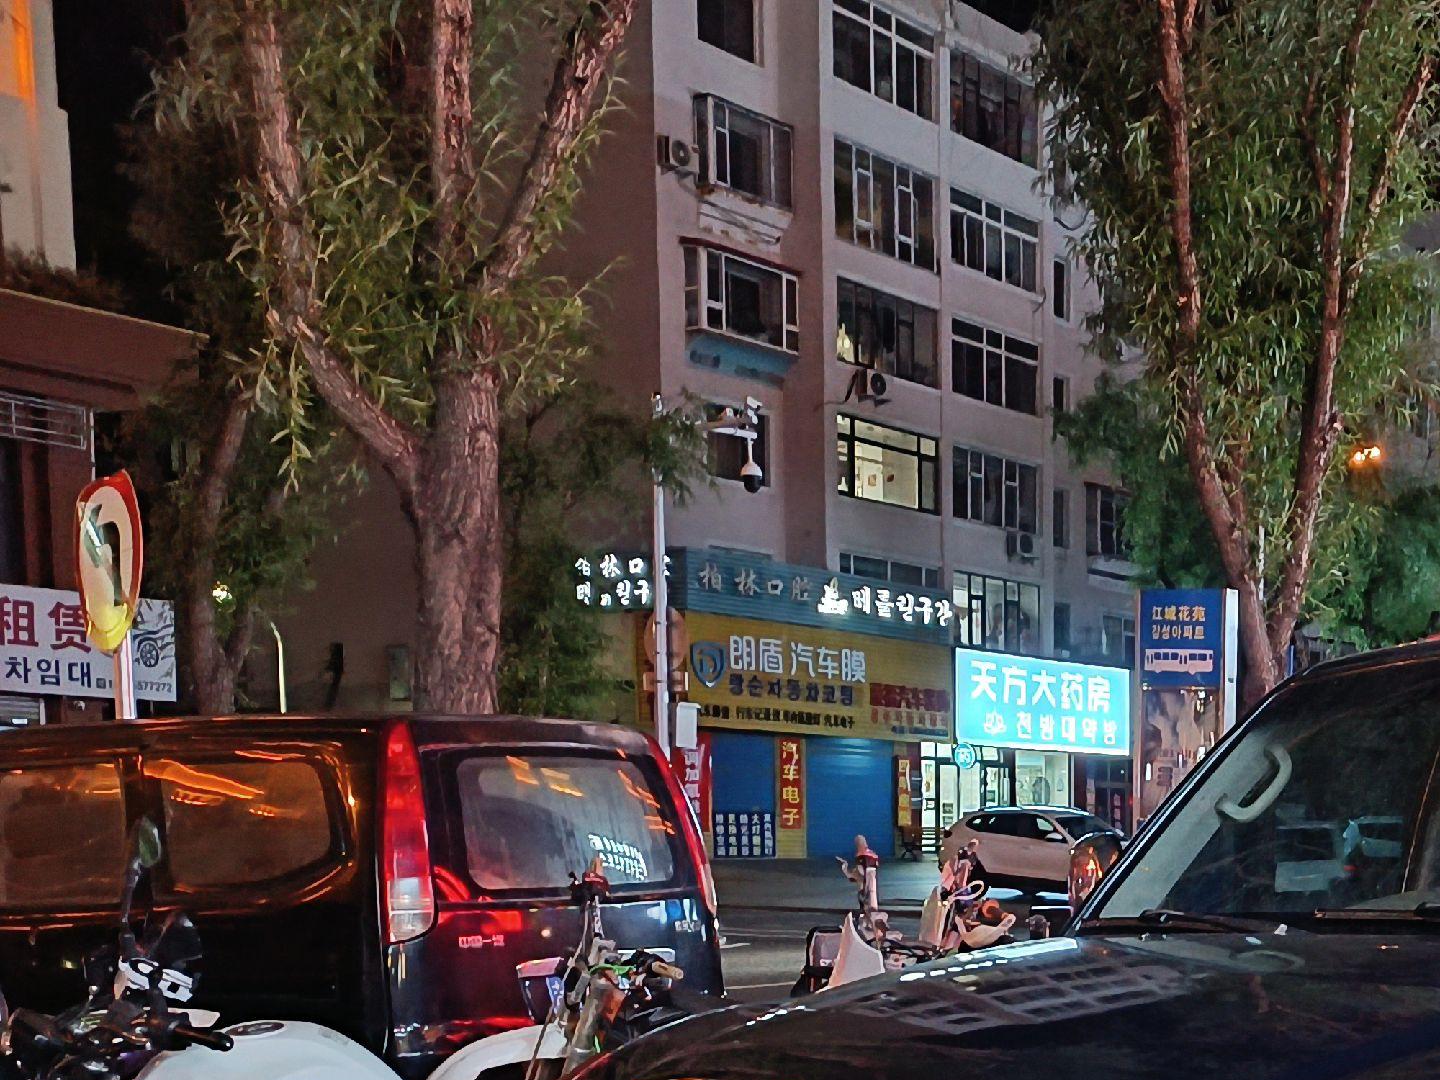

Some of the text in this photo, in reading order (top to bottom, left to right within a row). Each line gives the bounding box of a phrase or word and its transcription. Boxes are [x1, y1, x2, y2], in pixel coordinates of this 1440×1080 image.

[699, 561, 812, 600] 柏林口腔
[852, 586, 953, 627] 베를린구강
[5, 656, 92, 688] 차임대
[970, 660, 1112, 713] 天方大药房
[782, 741, 800, 826] 汽车电子
